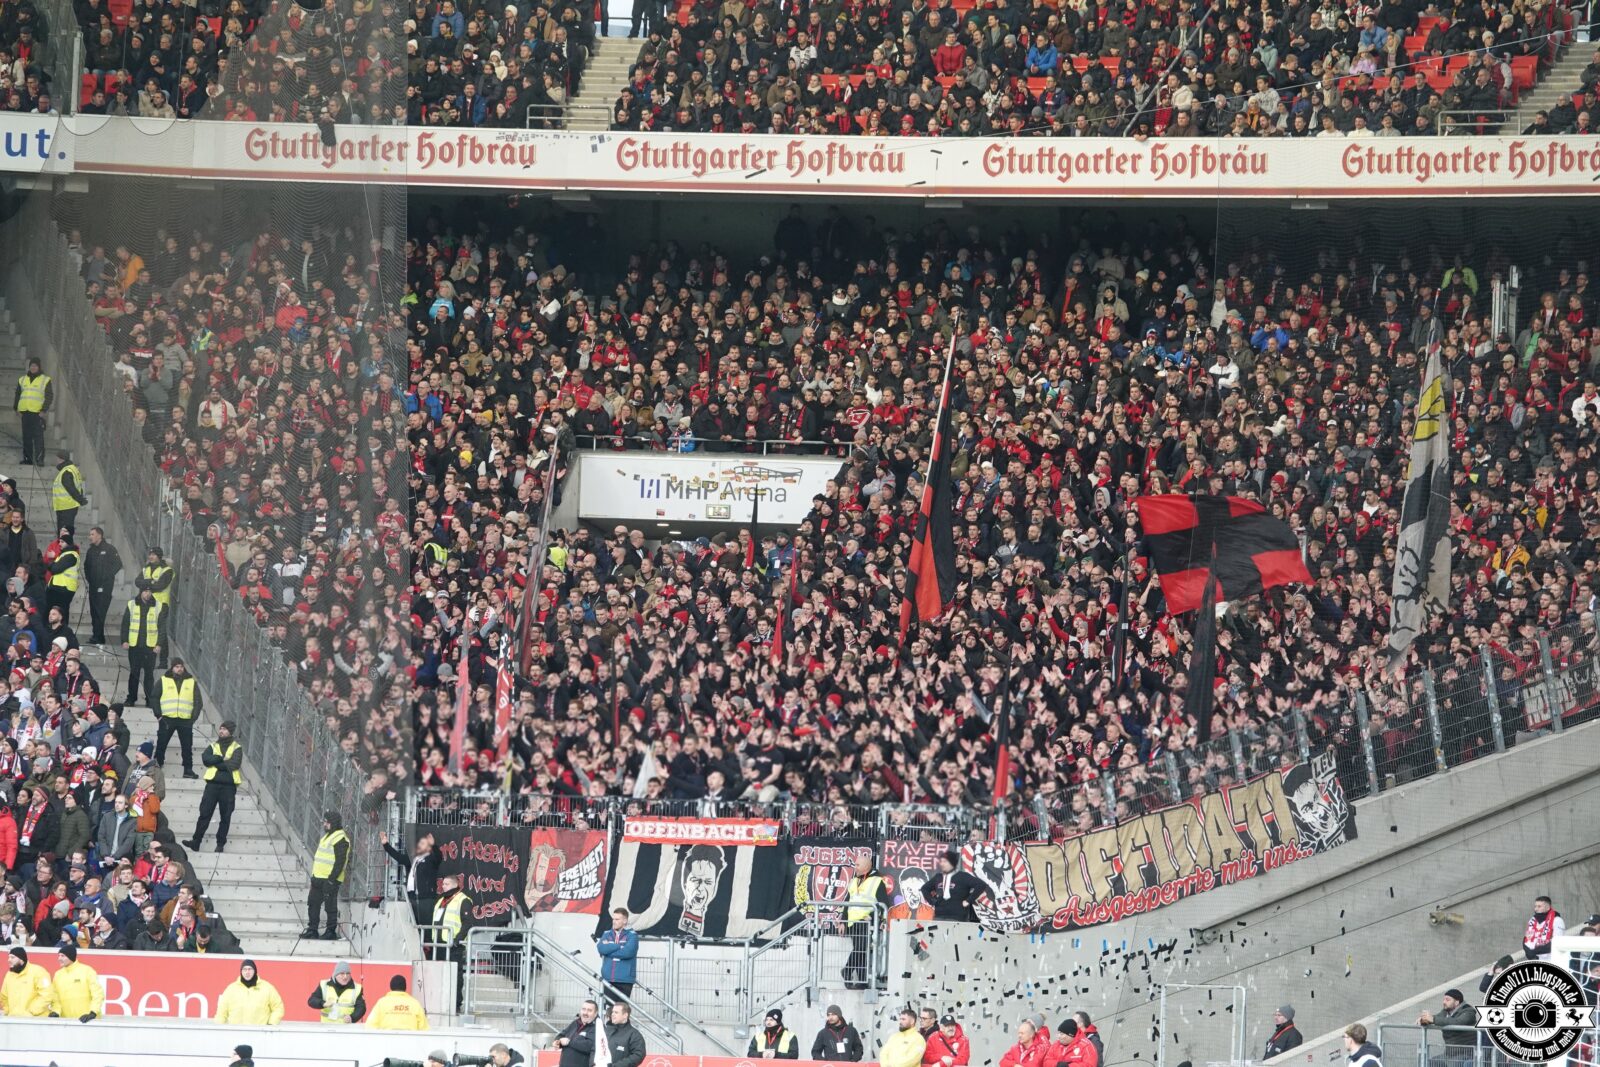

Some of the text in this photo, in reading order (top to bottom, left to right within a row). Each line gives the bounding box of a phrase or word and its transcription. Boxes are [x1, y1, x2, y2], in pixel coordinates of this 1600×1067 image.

[245, 127, 408, 169] Stuttgarter
[616, 137, 778, 178] Stuttgarter
[785, 140, 905, 178] Hofbräu
[982, 142, 1268, 183] Stuttgarter Hofbräu
[1342, 141, 1600, 183] Stuttgarter Hofbrä
[665, 478, 787, 503] MHP Arena
[629, 821, 748, 840] OFFENBACH
[884, 840, 949, 854] RAVER
[1025, 771, 1301, 917] DIFFIDATI
[559, 840, 604, 882] FREIHEIT
[581, 868, 598, 887] DIE
[557, 881, 602, 900] ULTRAS
[817, 876, 847, 888] BAYER
[1053, 866, 1215, 929] Ausgesperrte
[1221, 848, 1258, 885] mit
[98, 974, 216, 1018] Ben
